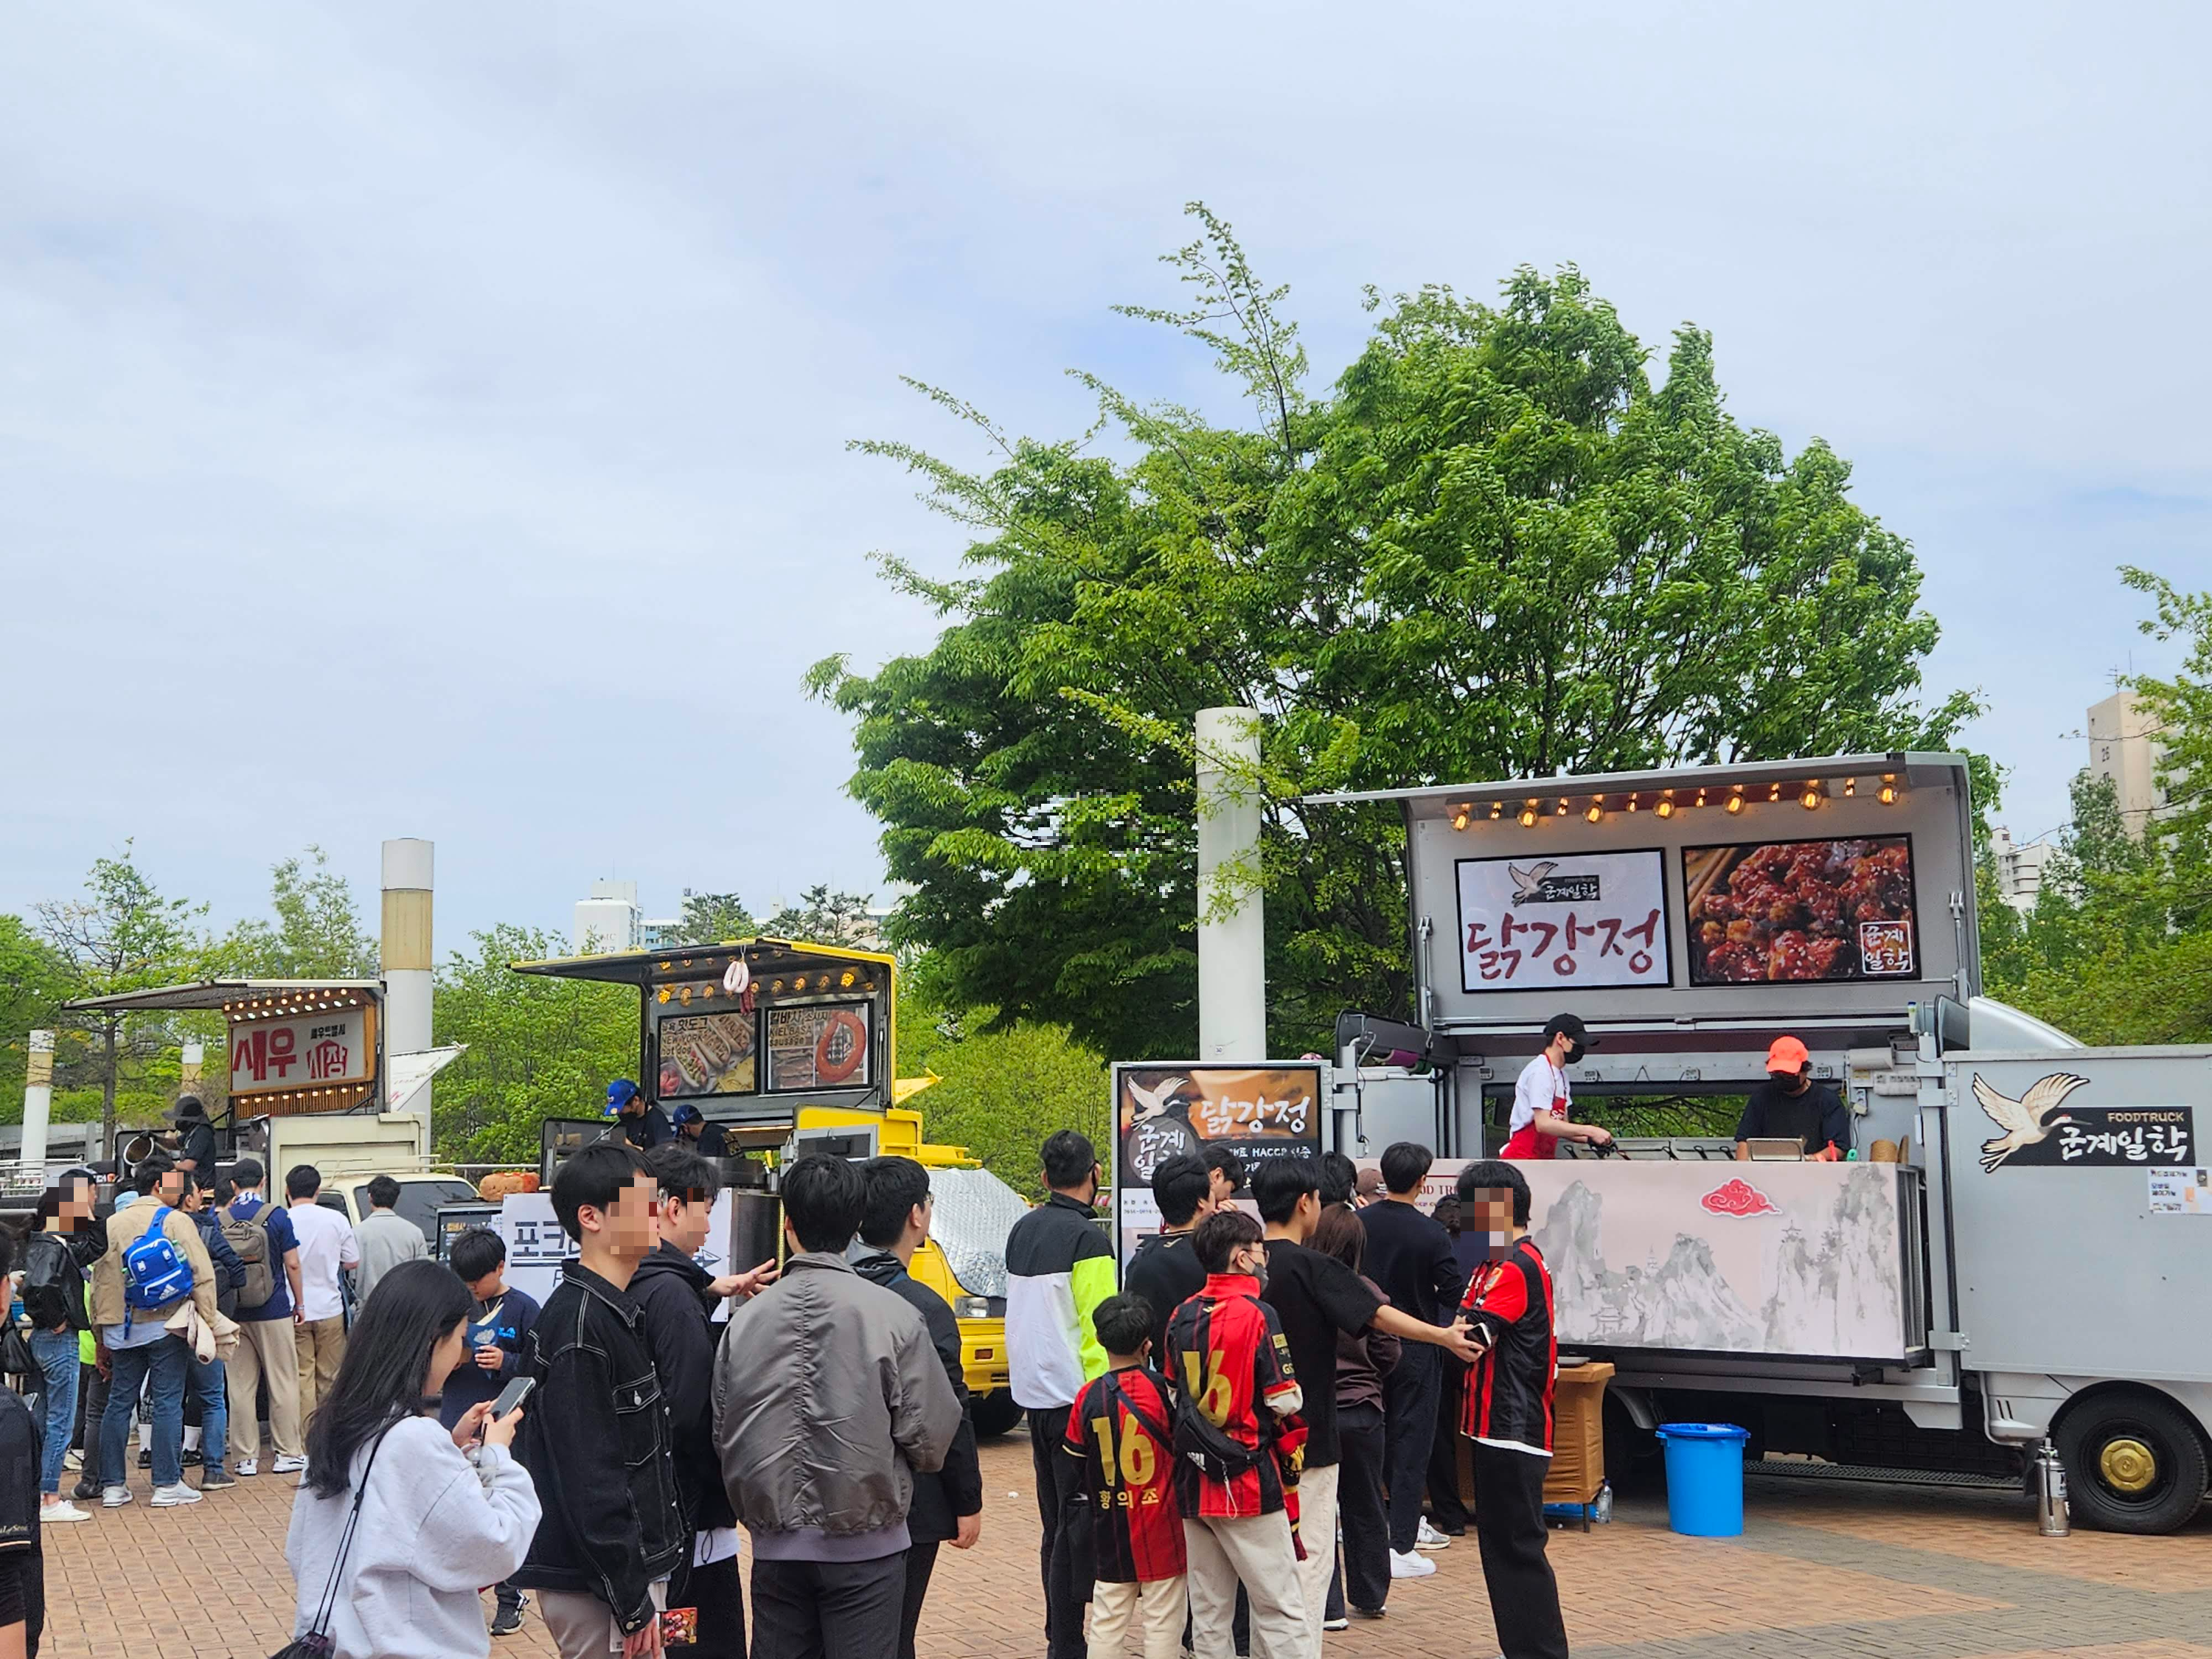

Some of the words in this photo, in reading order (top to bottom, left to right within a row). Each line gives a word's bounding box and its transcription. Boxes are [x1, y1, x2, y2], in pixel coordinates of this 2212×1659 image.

[1545, 883, 1598, 900] 군계일학
[1467, 908, 1661, 980] 닭강정
[1864, 925, 1904, 948] 군계
[1865, 947, 1909, 970] 일학
[678, 1018, 708, 1031] 핫도그
[770, 1026, 812, 1037] KIELBASA
[681, 1033, 703, 1043] YORK
[232, 1027, 296, 1081] 새우
[1200, 1096, 1311, 1134] 닭강정
[2107, 1112, 2184, 1122] FOODTRUCK
[1138, 1124, 1186, 1154] 군계
[2059, 1126, 2188, 1162] 군계일학
[1252, 1148, 1287, 1158] HACCP
[1182, 1350, 1232, 1428] 16
[1091, 1411, 1155, 1487] 16
[1099, 1488, 1160, 1510] 황의조
